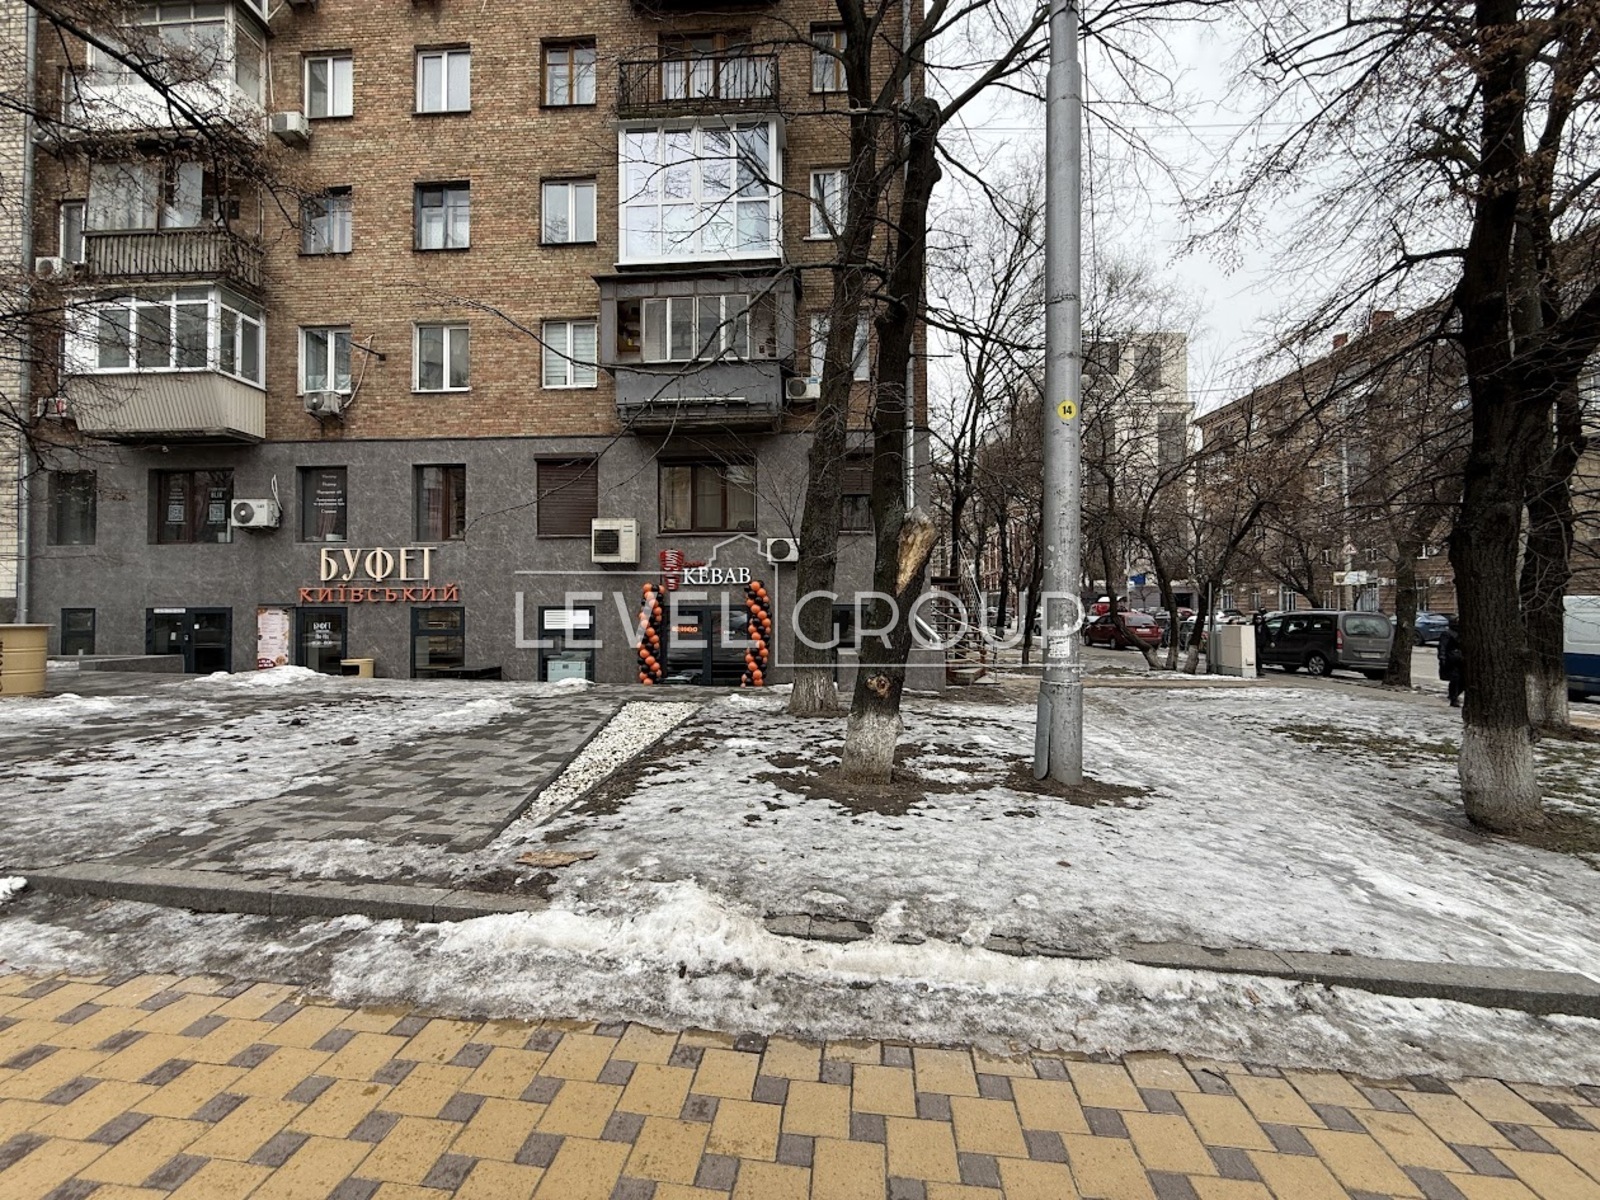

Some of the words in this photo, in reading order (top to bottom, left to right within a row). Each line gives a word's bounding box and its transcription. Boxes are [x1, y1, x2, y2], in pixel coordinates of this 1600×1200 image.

[1062, 405, 1073, 415] 14
[320, 547, 437, 582] БУФЕТ
[682, 567, 751, 585] KEBAB
[298, 584, 459, 603] КИЇВСЬКИЙ
